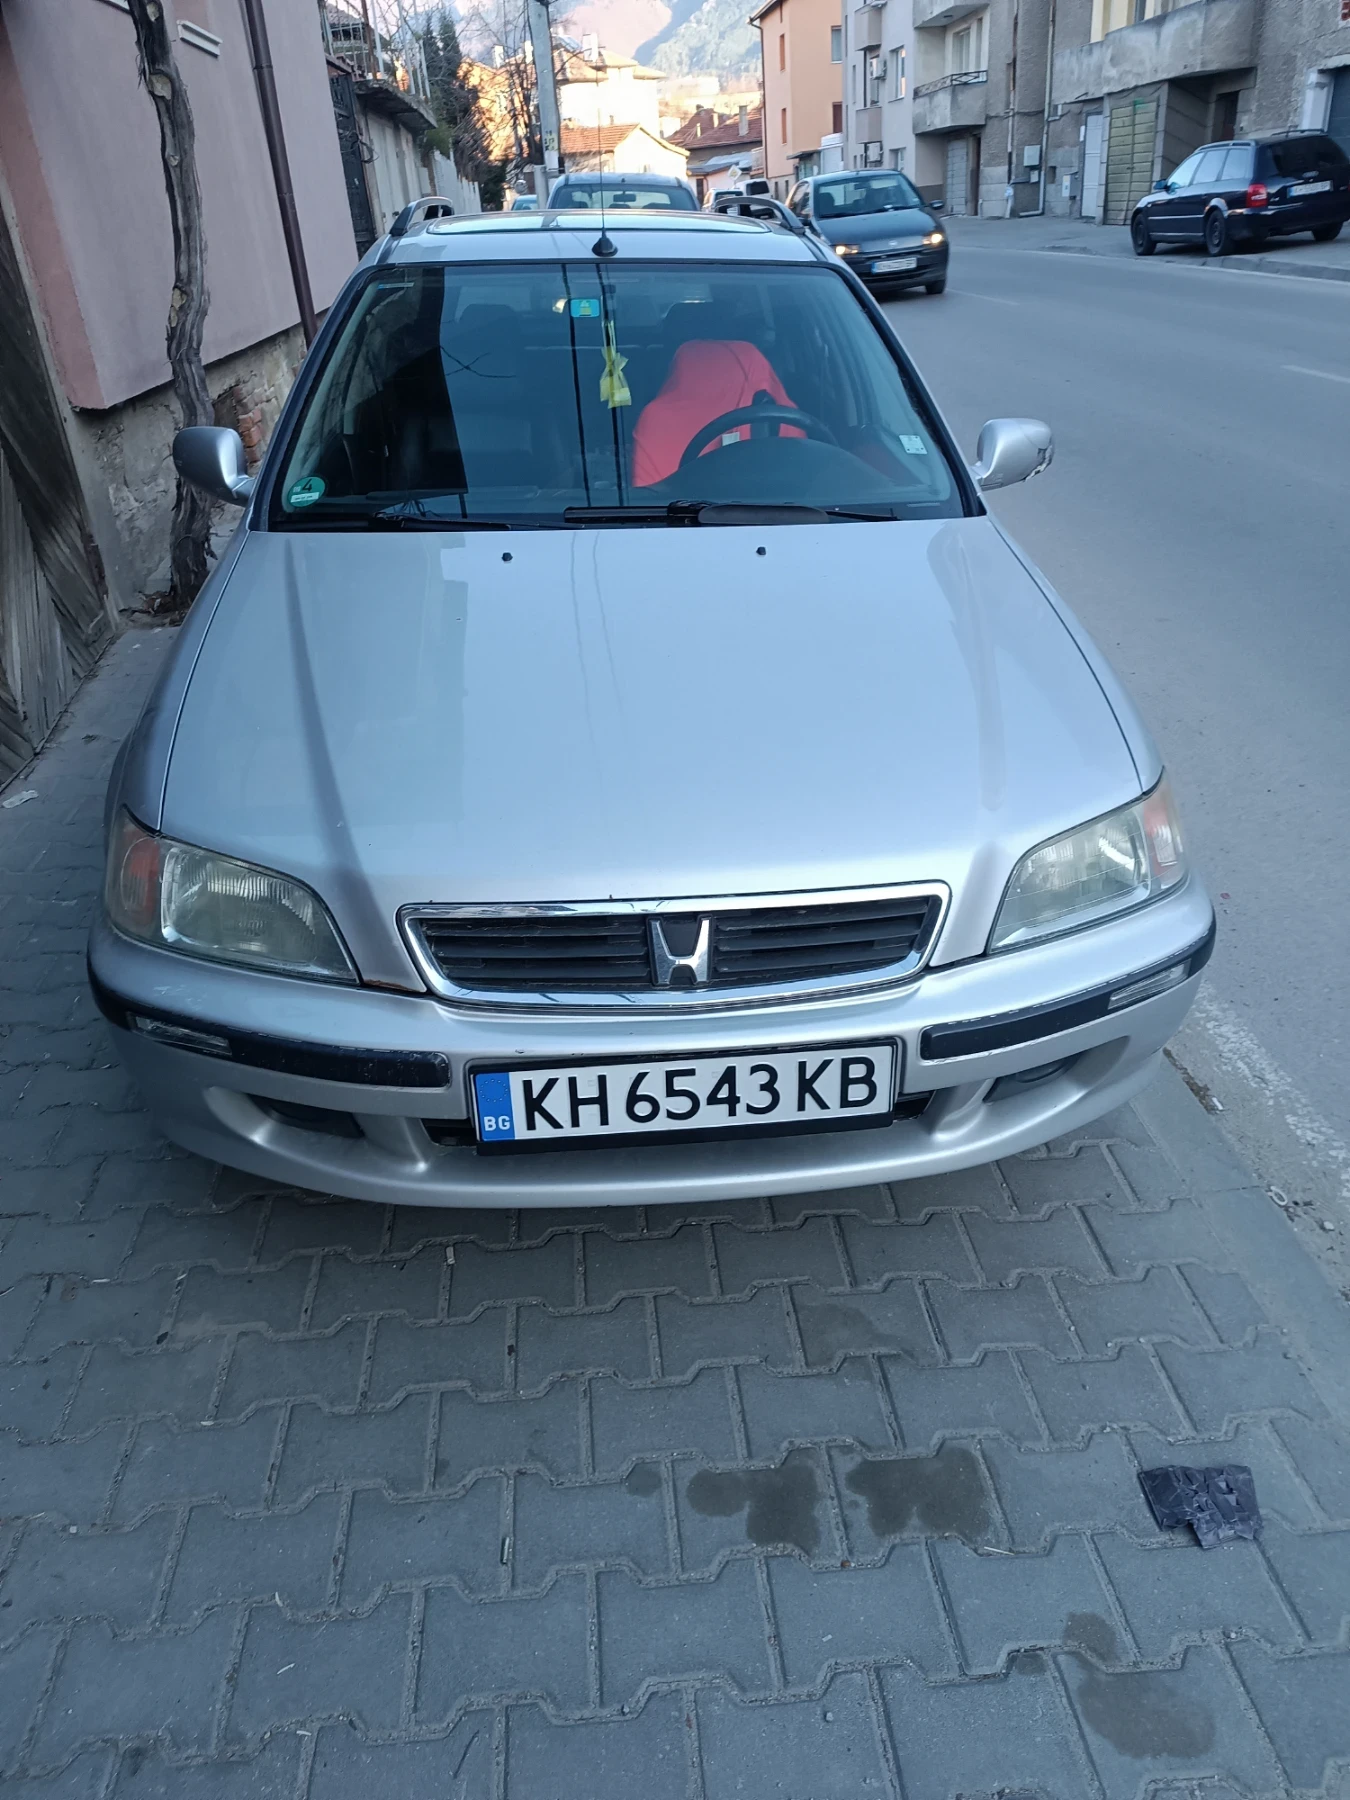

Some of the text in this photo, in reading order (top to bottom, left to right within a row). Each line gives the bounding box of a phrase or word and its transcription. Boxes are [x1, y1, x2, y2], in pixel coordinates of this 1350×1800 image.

[302, 478, 312, 491] 4
[522, 1056, 878, 1131] KH 6543 KB
[483, 1115, 510, 1131] BG
